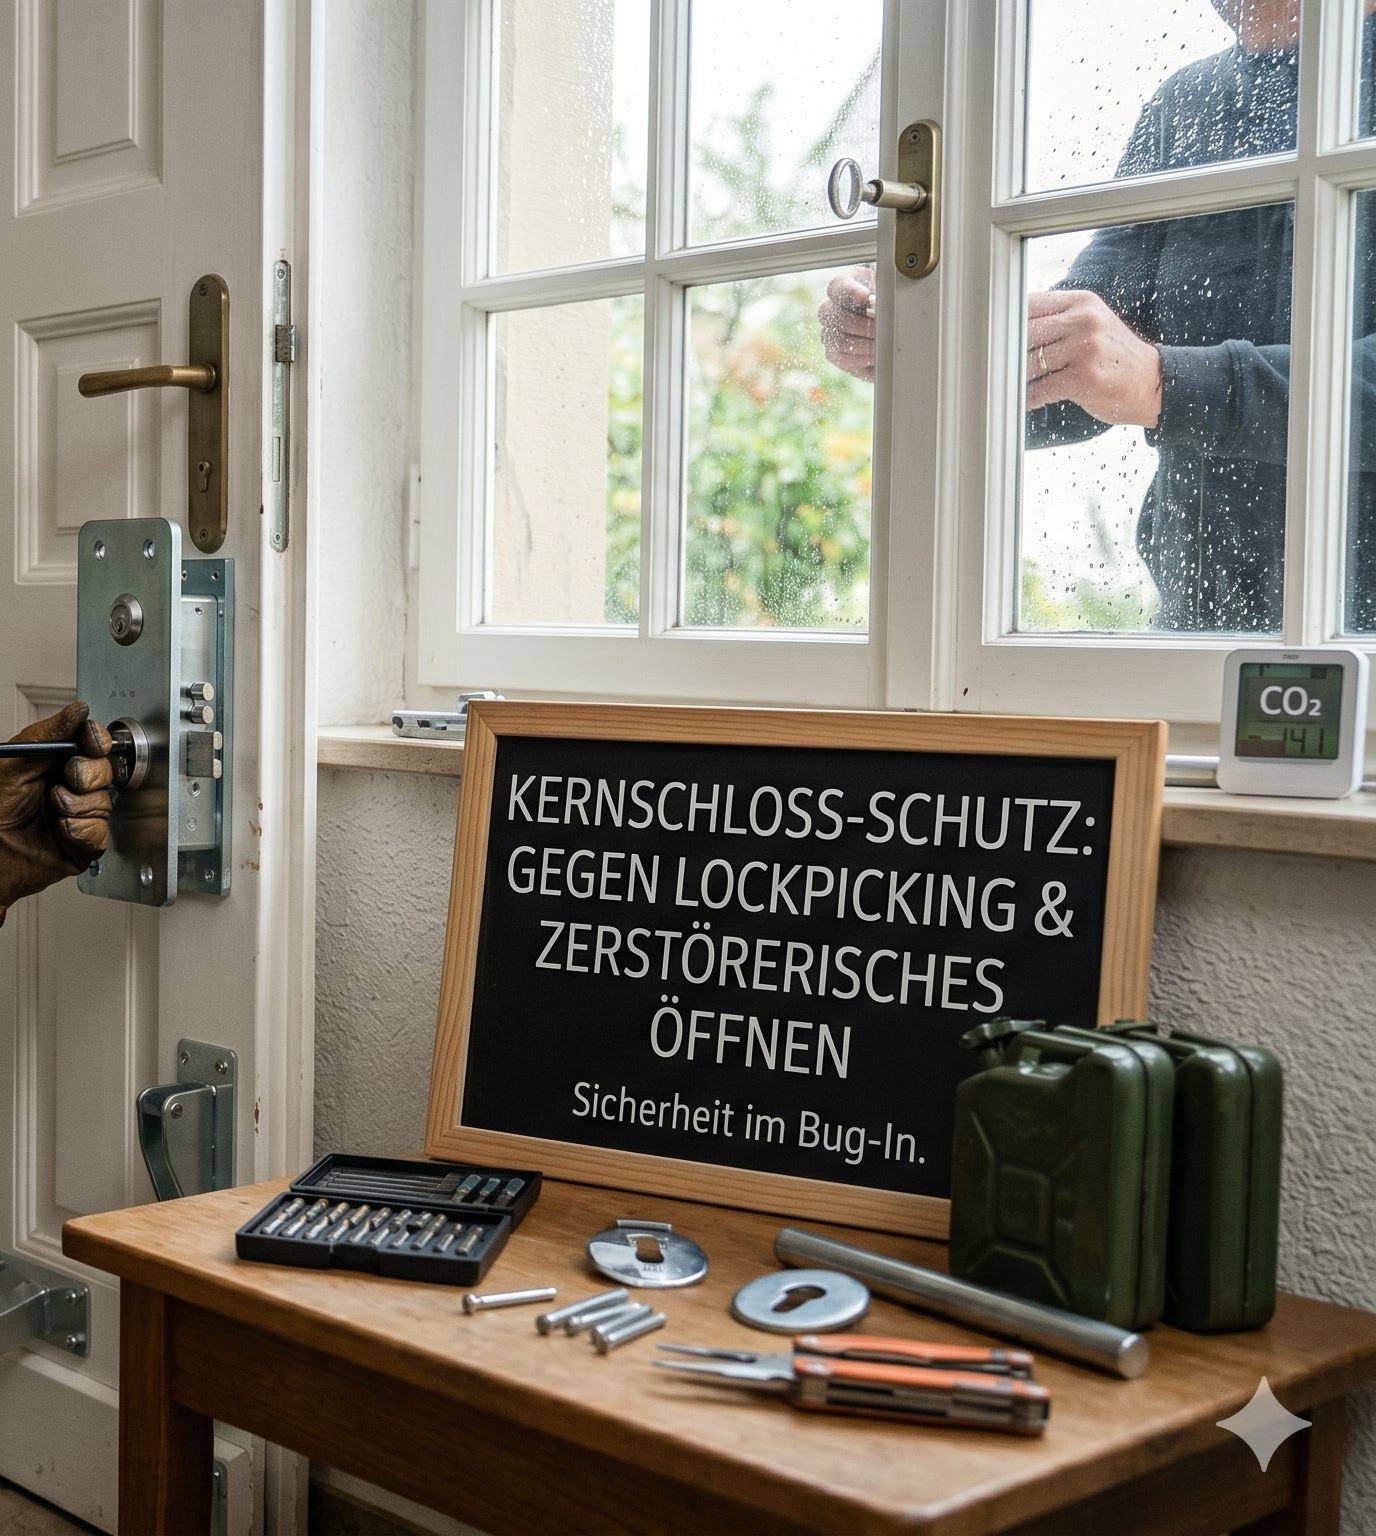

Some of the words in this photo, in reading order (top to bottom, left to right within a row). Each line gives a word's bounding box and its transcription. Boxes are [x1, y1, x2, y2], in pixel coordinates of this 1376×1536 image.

[508, 774, 1096, 855] KERNSCHLOSS-SCHUTZ:
[507, 845, 660, 904] GEGEN
[675, 856, 1016, 933] LOCKPICKING
[1034, 880, 1074, 938] &
[535, 919, 1005, 1013] ZERSTÖRERISCHES
[650, 994, 851, 1079] ÖFFNEN
[572, 1081, 735, 1137] Sicherheit
[745, 1113, 785, 1144] im
[798, 1110, 925, 1165] Bug-In.
